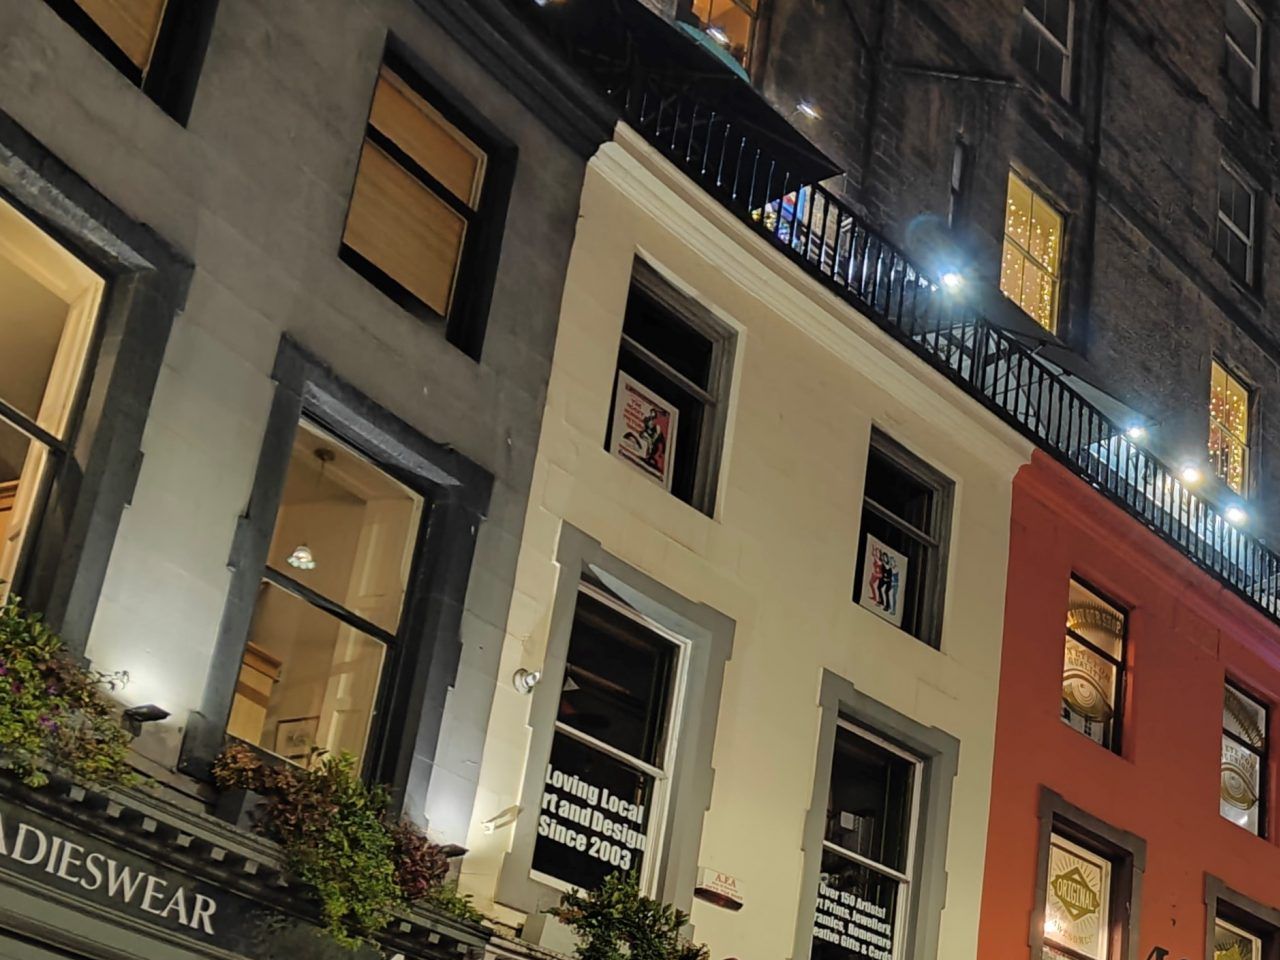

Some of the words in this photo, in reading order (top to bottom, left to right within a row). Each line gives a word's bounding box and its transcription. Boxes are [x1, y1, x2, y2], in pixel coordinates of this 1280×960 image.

[545, 763, 599, 806] Loving
[600, 788, 645, 824] Local
[541, 791, 559, 813] rt
[558, 800, 592, 827] and
[590, 810, 647, 851] Design
[538, 815, 587, 851] Since
[588, 836, 632, 870] 2003
[0, 811, 217, 935] DIESWEAR
[820, 883, 840, 900] Over
[841, 891, 855, 907] 150
[856, 897, 887, 919] Artists!
[1057, 878, 1095, 910] ORIGINAL
[824, 900, 851, 920] Prints,
[852, 910, 891, 937] Jewellery,
[848, 923, 891, 949] Homeware
[841, 935, 860, 952] Gifts
[861, 944, 867, 955] &
